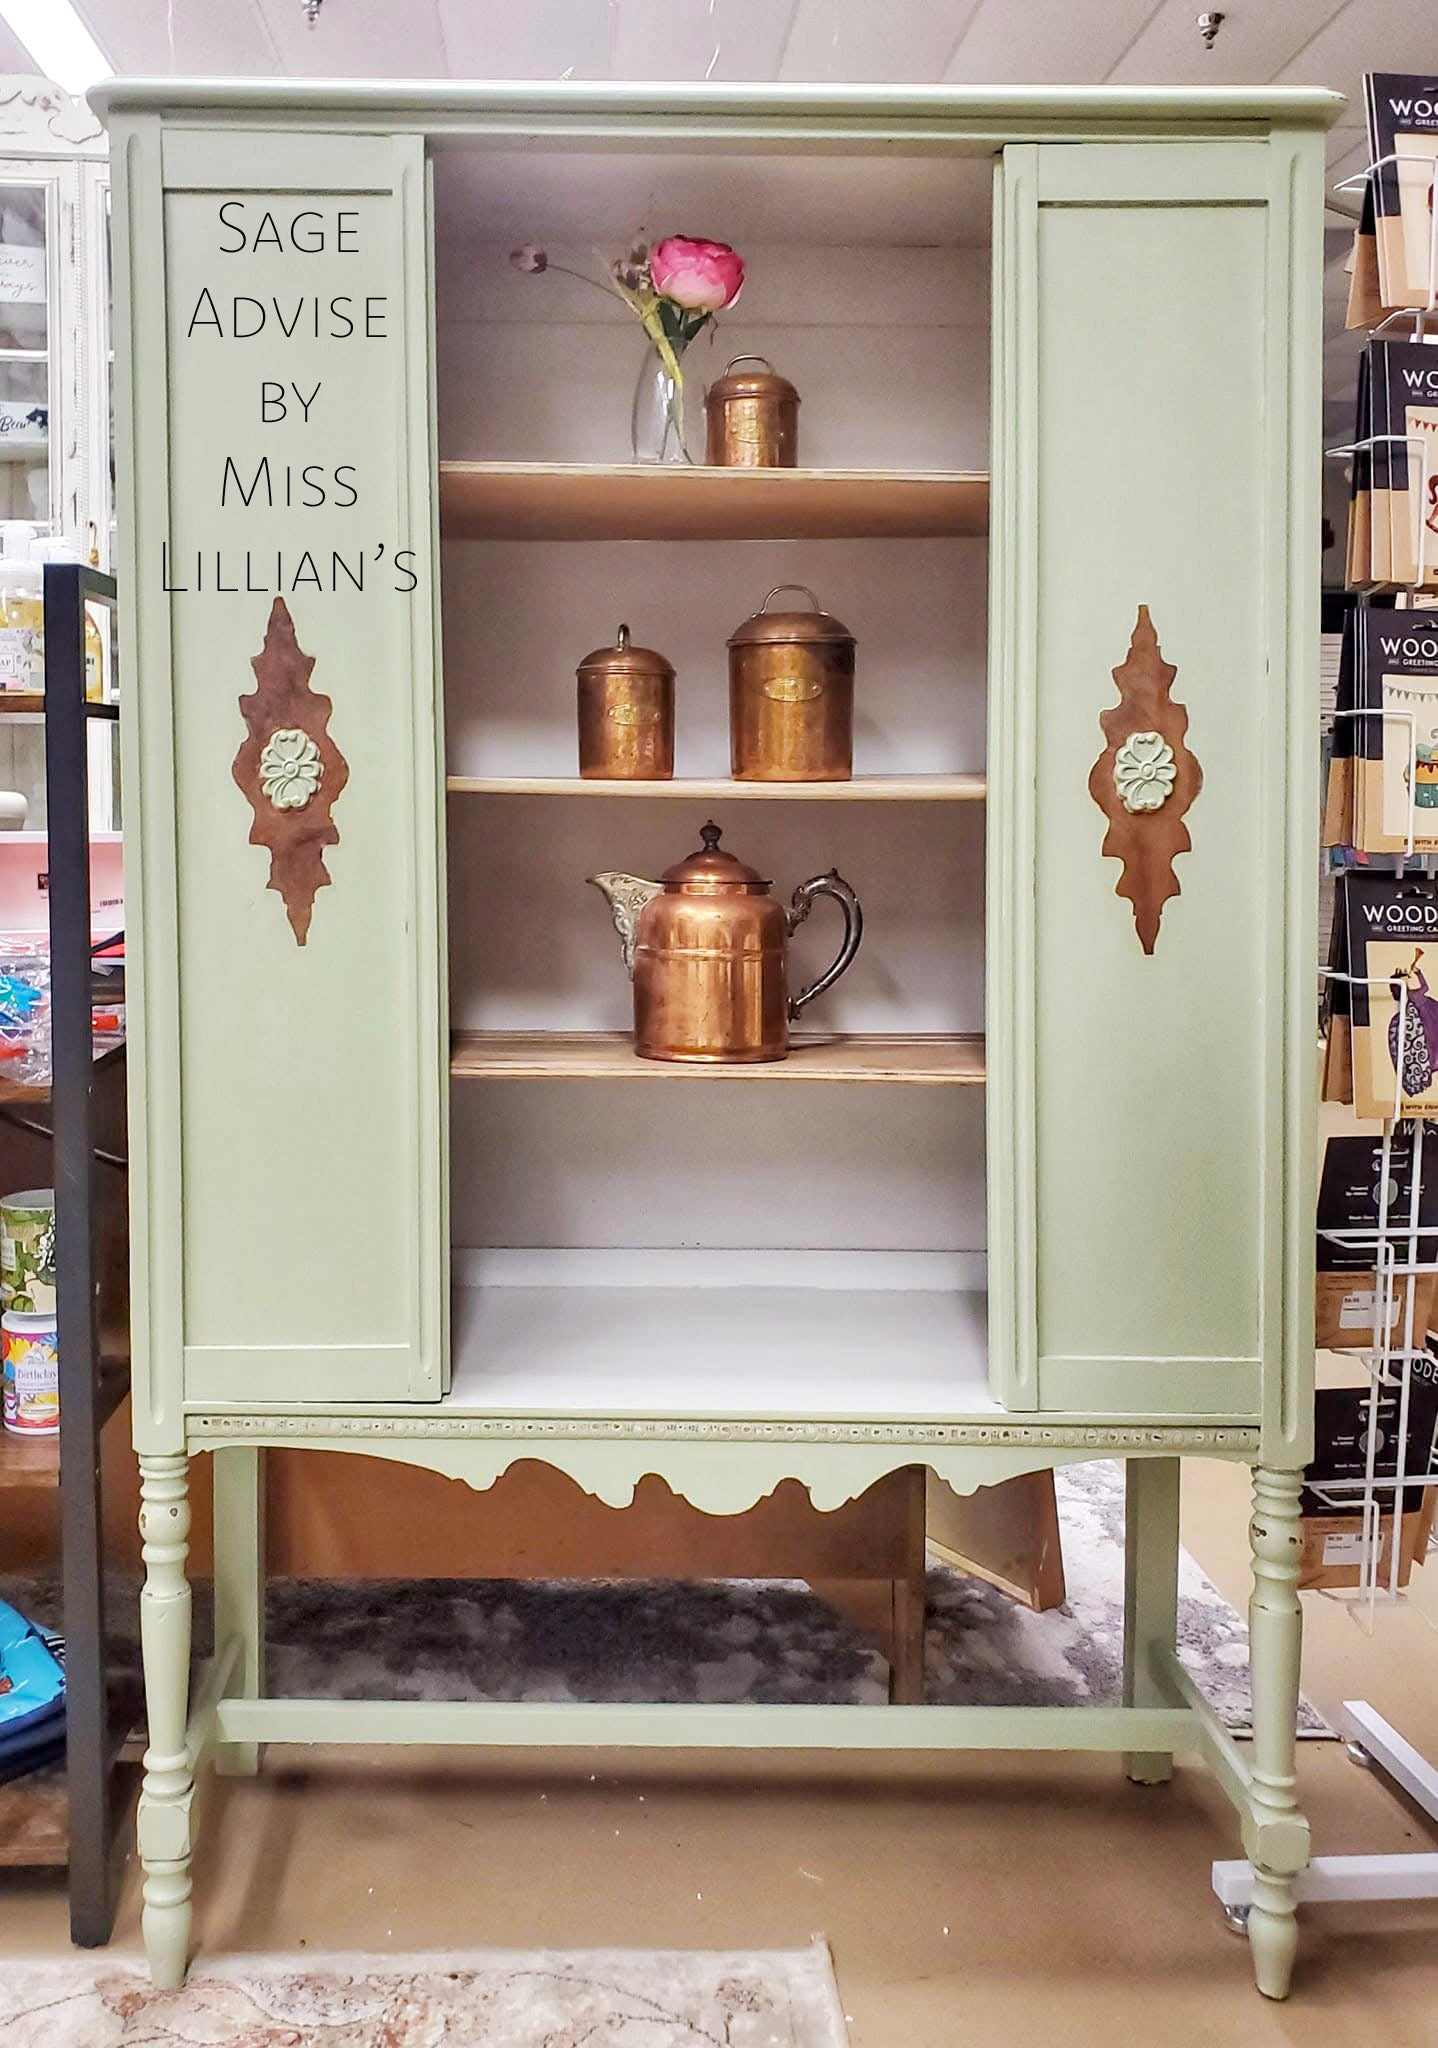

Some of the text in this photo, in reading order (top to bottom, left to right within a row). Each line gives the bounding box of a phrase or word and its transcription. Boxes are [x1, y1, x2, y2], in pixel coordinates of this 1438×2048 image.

[1389, 99, 1438, 117] WO
[1362, 904, 1438, 924] WOOD
[17, 1369, 57, 1381] Birthday
